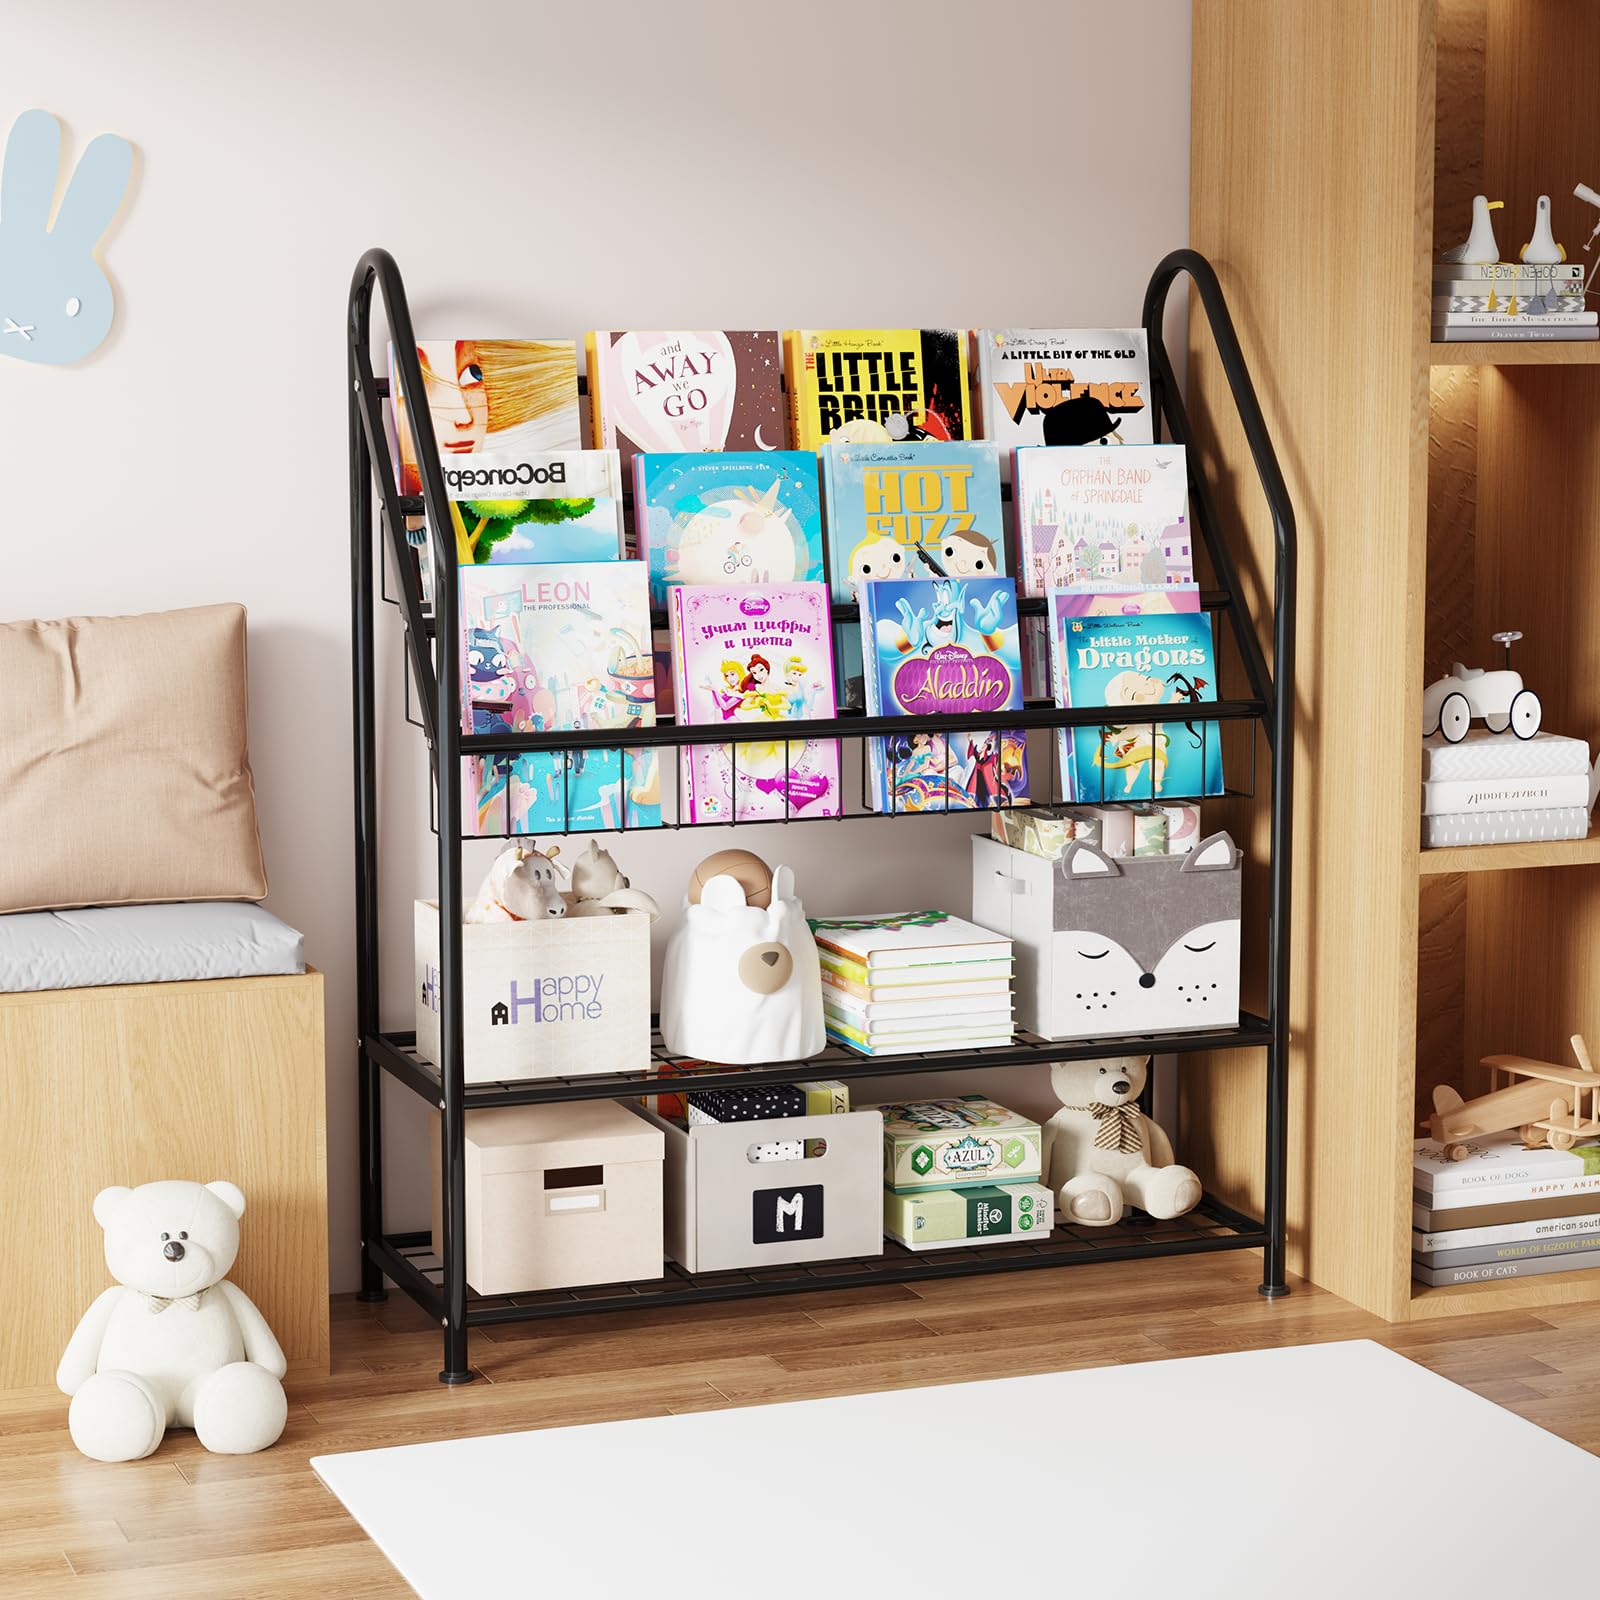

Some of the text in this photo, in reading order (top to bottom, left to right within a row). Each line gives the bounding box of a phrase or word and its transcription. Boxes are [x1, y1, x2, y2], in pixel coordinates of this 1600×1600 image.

[660, 340, 682, 356] and
[1001, 350, 1136, 360] A LITTLE BIT OF THE OLD
[805, 352, 815, 371] THE
[634, 352, 718, 396] AWAY
[816, 352, 918, 392] LITTLE
[672, 380, 690, 392] we
[662, 388, 708, 417] GO
[1098, 456, 1112, 464] THE
[1061, 468, 1151, 486] ORPHAN BAND
[863, 470, 973, 514] HOT
[1083, 489, 1143, 503] SPRINGDALE
[522, 581, 590, 603] LEON
[538, 603, 591, 611] PROFESSIONAL
[754, 620, 812, 634] цифры
[724, 637, 793, 650] и цвета
[1089, 636, 1132, 648] Little
[1135, 633, 1190, 646] Mother
[1077, 646, 1206, 672] Dragons
[901, 664, 1004, 703] Aladdin
[953, 1149, 985, 1163] AZUL
[1461, 1175, 1487, 1185] BOOK
[1505, 1171, 1529, 1180] DOGS
[1531, 1183, 1565, 1193] HAPPY
[776, 1192, 804, 1232] M
[982, 1202, 990, 1231] Mindful
[1535, 1223, 1577, 1234] american
[1496, 1244, 1527, 1257] WORLD
[1529, 1244, 1541, 1253] OF
[1543, 1240, 1579, 1252] EGZOTIC
[1453, 1266, 1518, 1281] BOOK OF CATS
